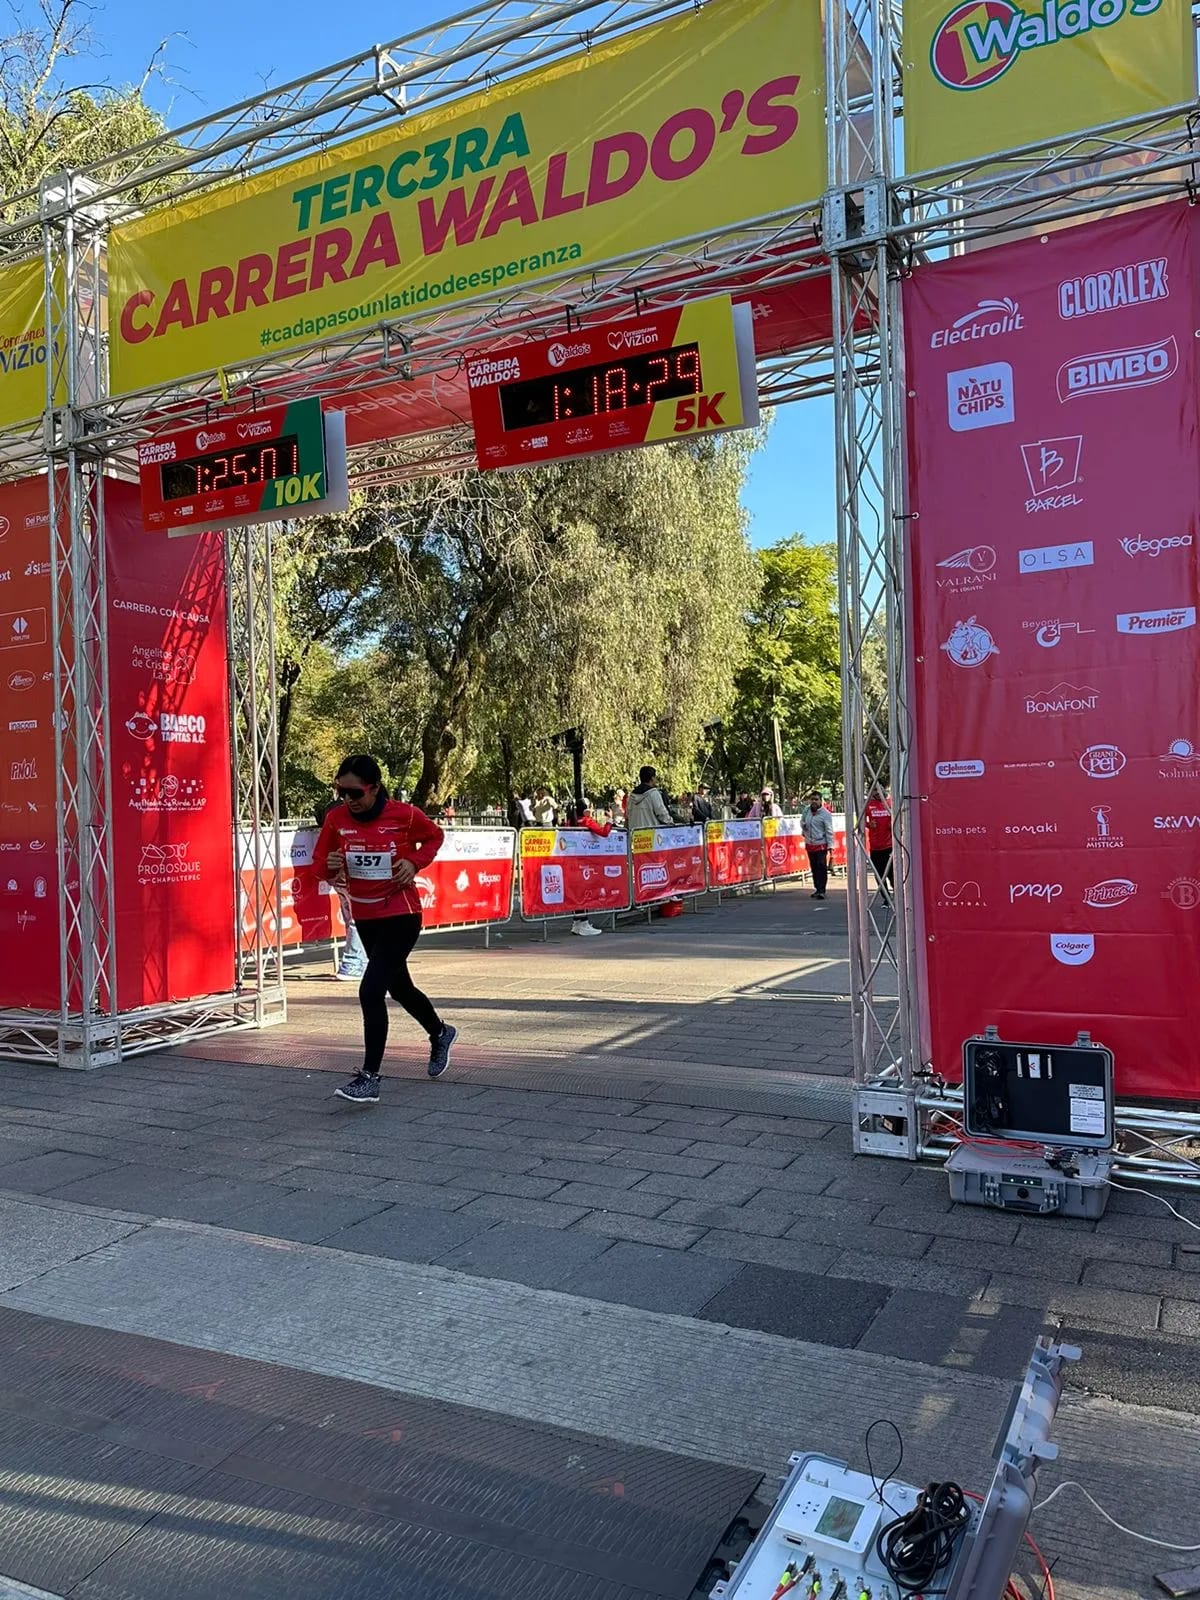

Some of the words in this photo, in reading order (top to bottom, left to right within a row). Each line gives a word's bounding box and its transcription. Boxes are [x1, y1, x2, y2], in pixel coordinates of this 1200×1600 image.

[292, 112, 530, 232] TERC3RA
[120, 212, 401, 344] CARRERA
[417, 75, 800, 257] WALDO'S
[260, 241, 582, 348] #cadapasounlatidodeesperanza
[1060, 258, 1168, 320] CLORALEX
[931, 313, 1024, 349] Electrolit
[625, 333, 658, 348] ViZion
[557, 343, 591, 360] Waldo's
[468, 357, 519, 377] CARRERA
[1068, 350, 1168, 389] BIMBO
[470, 367, 520, 388] WALDO'S
[674, 392, 726, 432] 5K
[957, 396, 1004, 415] CHIPS
[139, 441, 176, 457] CARRERA
[140, 450, 176, 466] WALDO'S
[275, 472, 323, 506] 10K
[1025, 494, 1083, 513] BARCEL
[1128, 533, 1193, 557] degasa
[1023, 547, 1086, 567] OLSA
[936, 573, 996, 587] VALRANI
[113, 600, 158, 615] CARRERA
[159, 608, 179, 618] CON
[181, 611, 210, 623] CAUSA
[1022, 619, 1059, 633] Beyond
[1128, 613, 1185, 630] Premier
[132, 645, 173, 660] Angelitos
[132, 657, 143, 667] de
[145, 659, 173, 671] Cristal
[1026, 696, 1099, 713] BONAFONT
[161, 713, 206, 733] BANCO
[1089, 751, 1119, 759] GRAND
[138, 862, 201, 875] PROBOSQUE
[355, 856, 381, 867] 357
[152, 874, 201, 884] CHAPULTEPEC
[641, 867, 667, 885] BIMBO
[1056, 942, 1090, 950] Colgate
